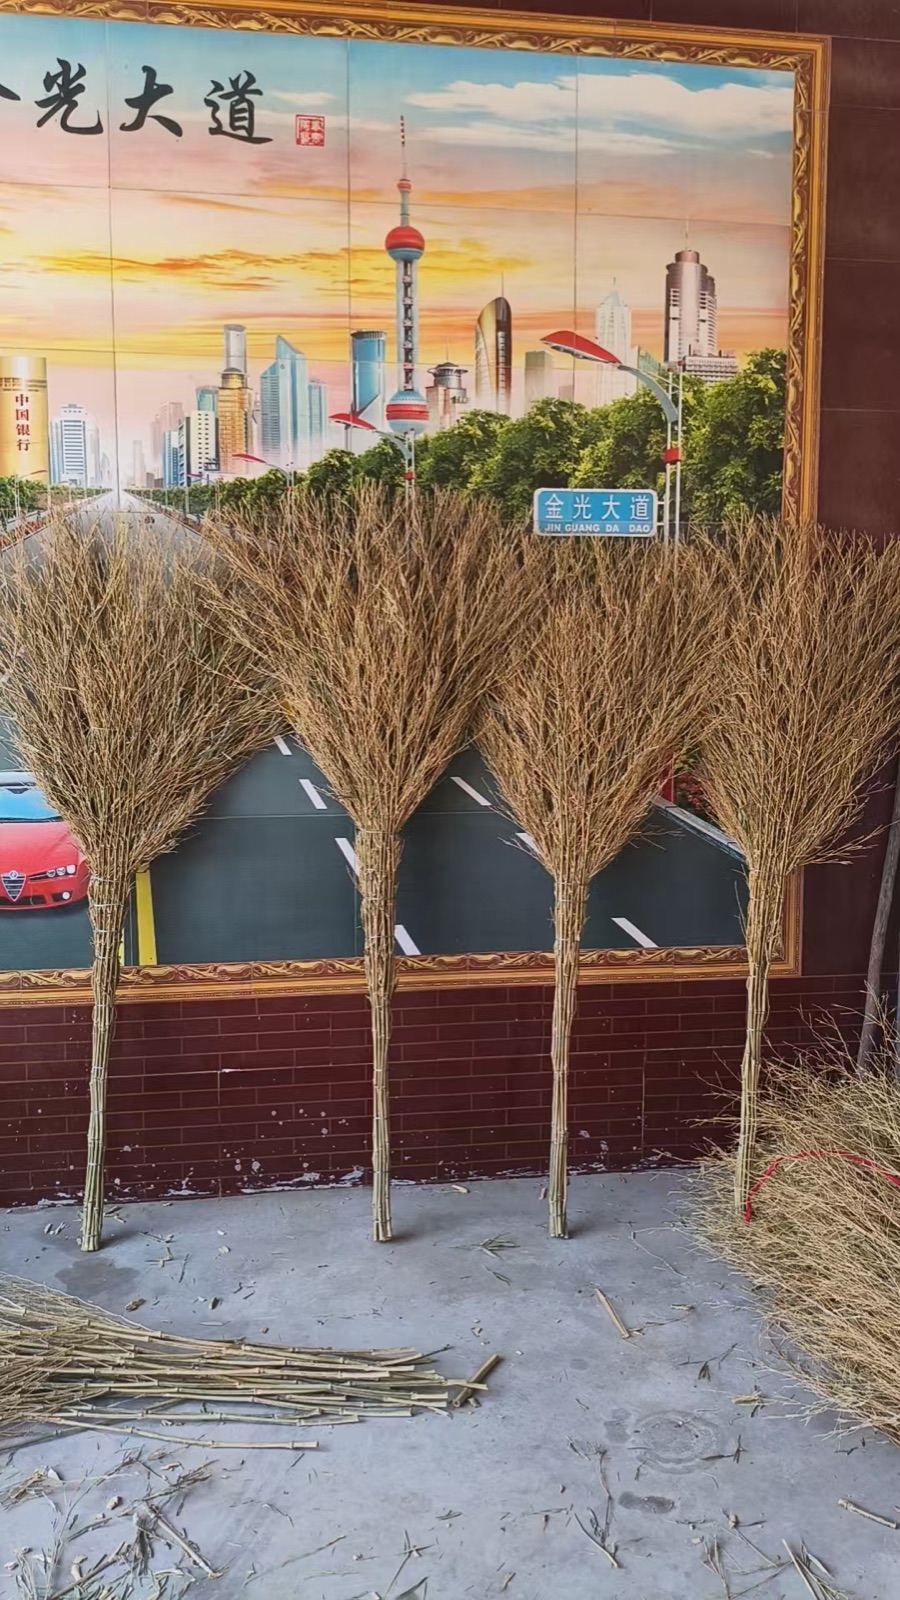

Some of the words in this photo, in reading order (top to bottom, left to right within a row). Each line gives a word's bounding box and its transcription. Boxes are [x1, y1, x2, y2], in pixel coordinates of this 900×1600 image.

[0, 58, 274, 145] 光大道
[15, 394, 30, 451] 中国银行
[545, 493, 649, 519] 金光大道
[545, 523, 560, 532] JIN
[565, 523, 600, 532] GUANG
[605, 524, 619, 532] DA
[629, 524, 650, 533] DAO
